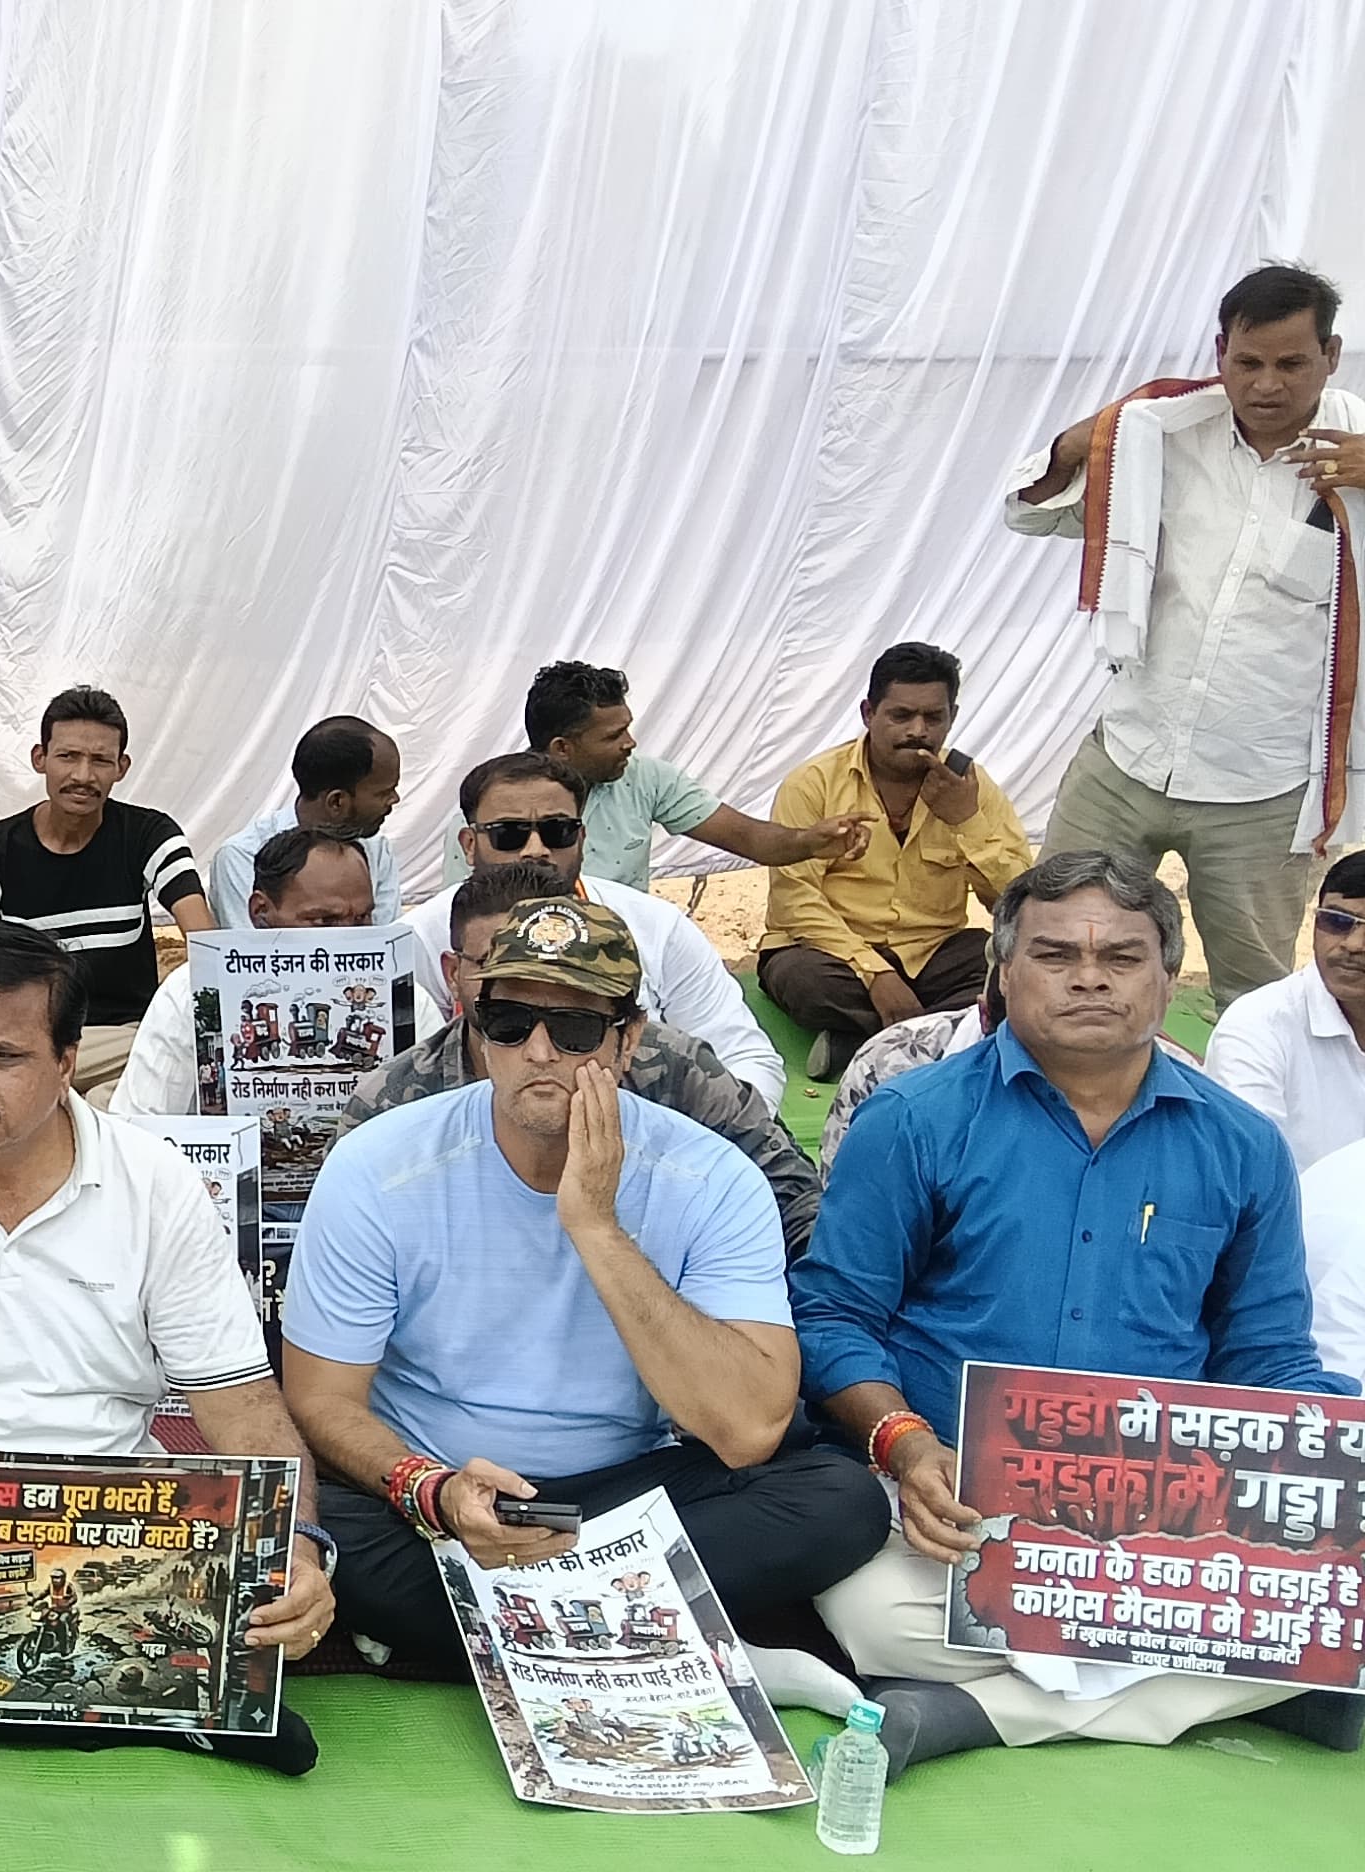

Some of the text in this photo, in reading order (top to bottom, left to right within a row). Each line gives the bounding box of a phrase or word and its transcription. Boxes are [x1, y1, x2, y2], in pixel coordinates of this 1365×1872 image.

[225, 948, 386, 976] टीपल इंजन की सरकार
[231, 1076, 251, 1099] रोड
[251, 1076, 290, 1099] निर्माण
[314, 1081, 336, 1098] करा
[1117, 1387, 1161, 1444] मे
[1168, 1403, 1289, 1462] सड़क
[1295, 1403, 1341, 1460] है
[21, 1481, 59, 1510] हम
[62, 1483, 99, 1520] पूरा
[102, 1480, 155, 1513] भरते
[155, 1480, 180, 1518] हैं,
[76, 1521, 105, 1542] पर
[106, 1521, 145, 1548] क्यों
[145, 1521, 189, 1549] मरते
[191, 1520, 219, 1549] हैं?
[585, 1528, 648, 1567] सरकार
[1012, 1540, 1362, 1610] जनता के हक की लड़ाई है
[1011, 1579, 1108, 1622] कांग्रेस
[1113, 1585, 1207, 1634] मैदान
[1210, 1603, 1247, 1639] मे
[1252, 1604, 1316, 1649] आई
[1316, 1606, 1346, 1649] है
[1060, 1622, 1302, 1665] डॉ खूबचंद बघेल ब्लॉक कांग्रेस कमेटी
[510, 1658, 534, 1691] रोड
[536, 1663, 582, 1690] निर्माण
[613, 1672, 642, 1691] करा
[644, 1664, 674, 1692] पाई
[673, 1663, 699, 1689] रही
[696, 1657, 713, 1684] है
